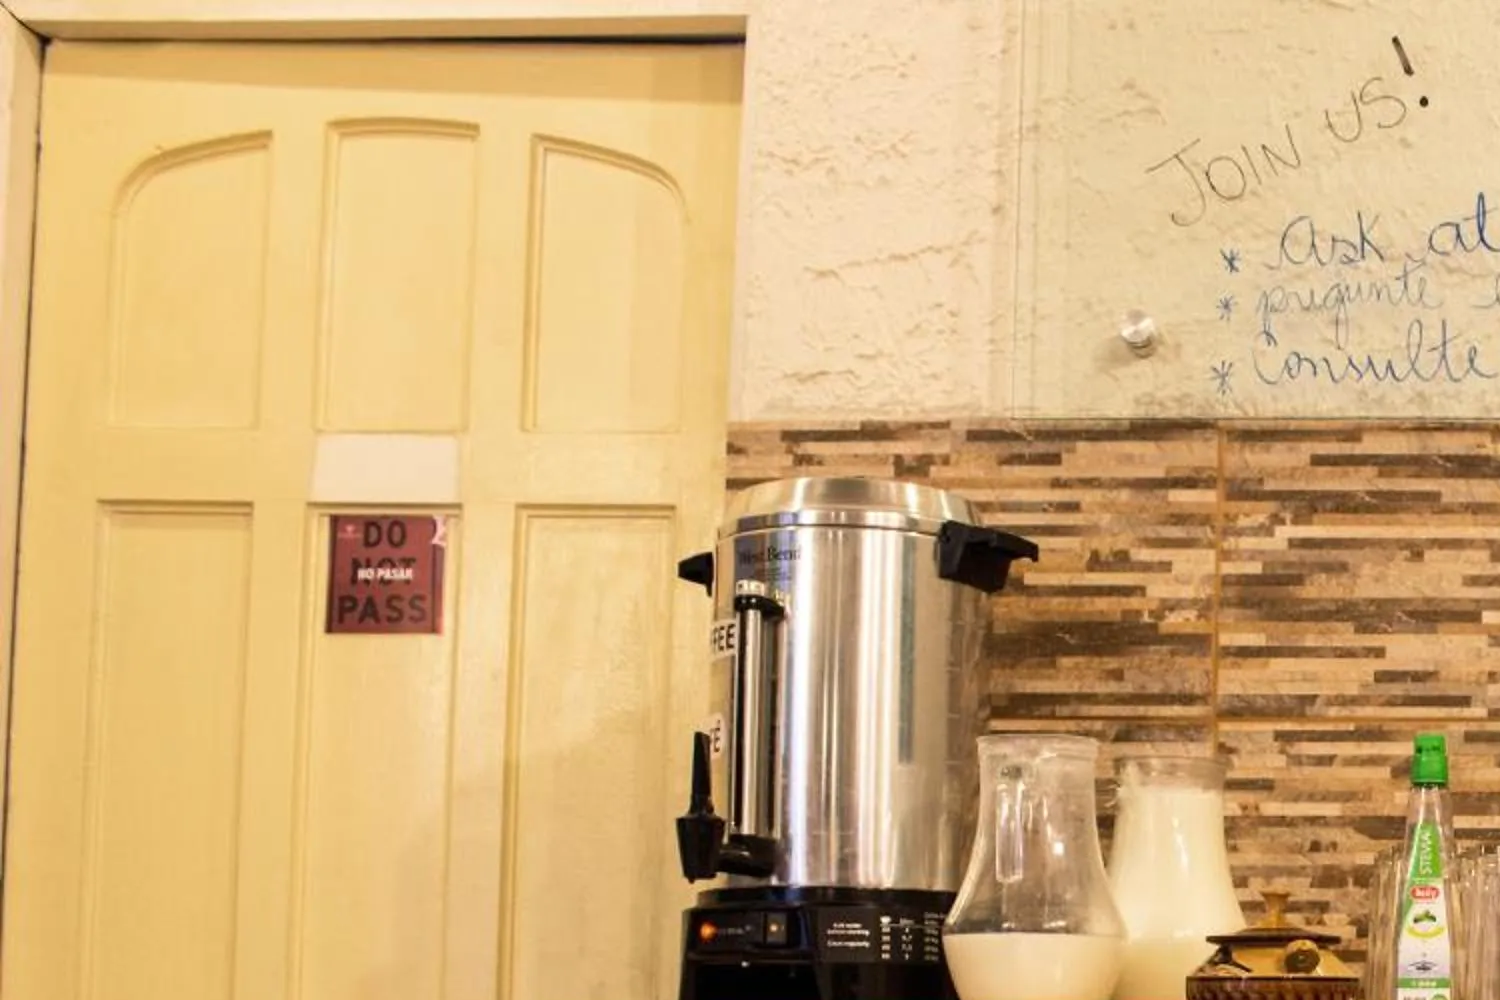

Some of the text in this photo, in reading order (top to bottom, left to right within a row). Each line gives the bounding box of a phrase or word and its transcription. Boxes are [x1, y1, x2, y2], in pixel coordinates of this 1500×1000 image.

[1145, 35, 1430, 227] JOIN US!
[363, 520, 407, 549] DO
[337, 593, 428, 625] PASS
[710, 623, 736, 652] FEE
